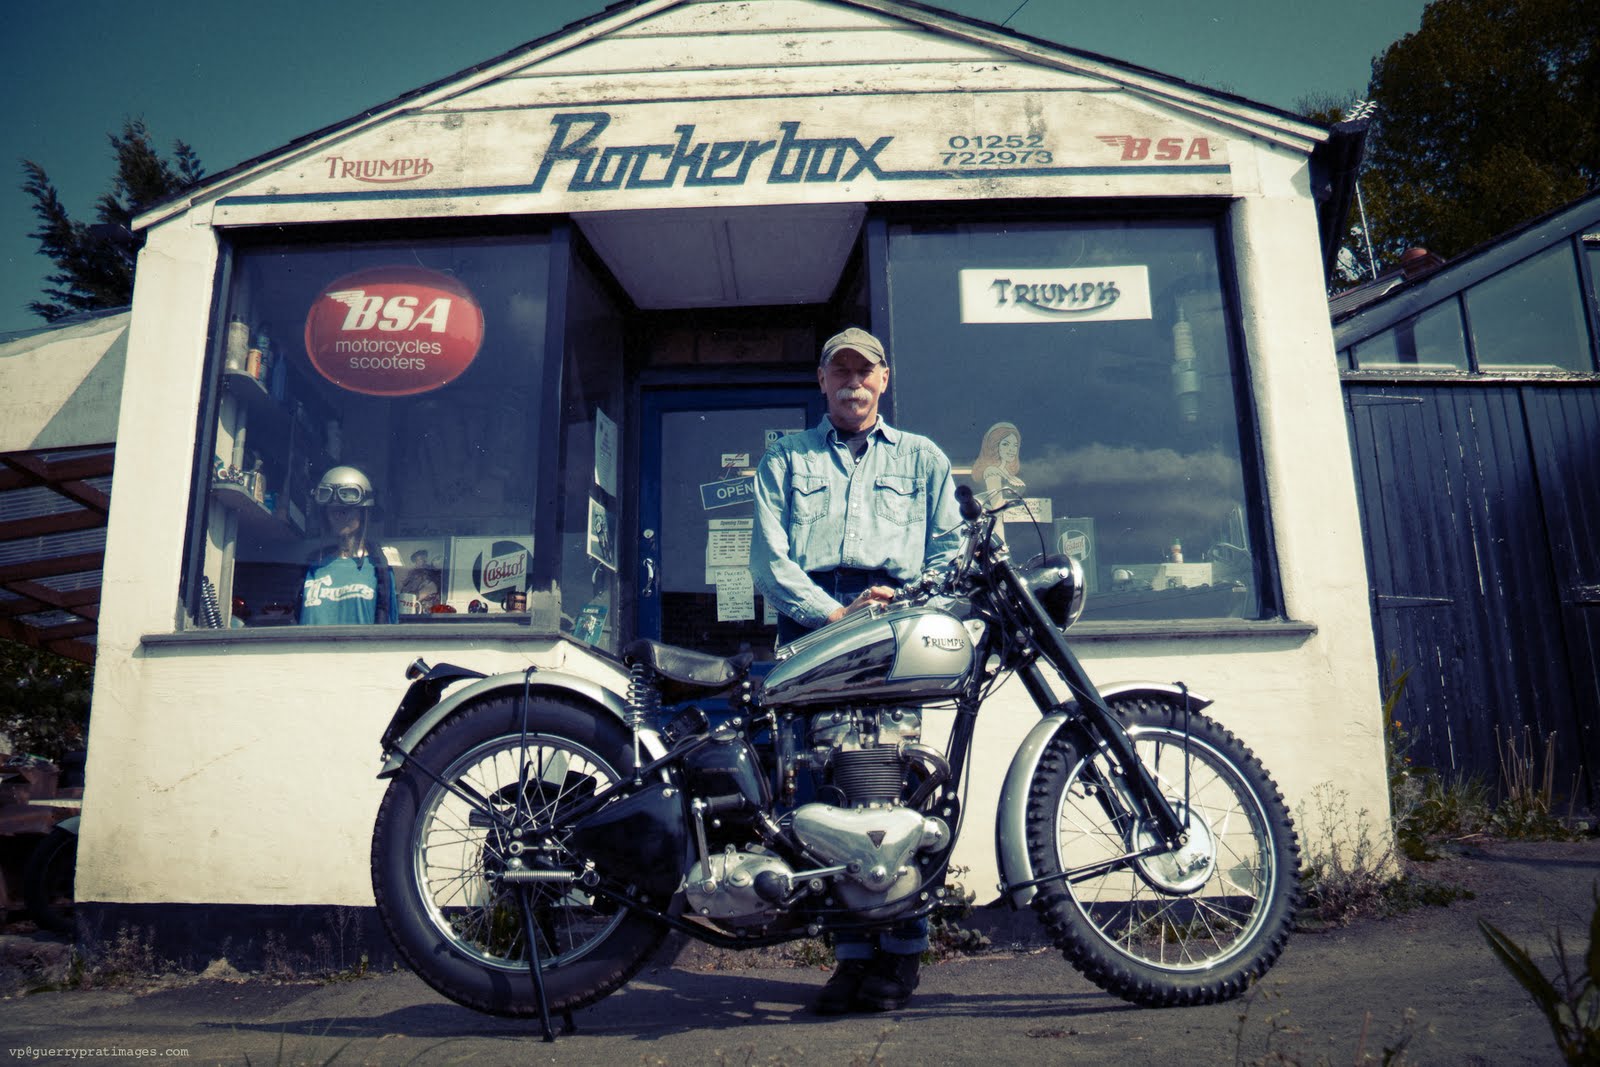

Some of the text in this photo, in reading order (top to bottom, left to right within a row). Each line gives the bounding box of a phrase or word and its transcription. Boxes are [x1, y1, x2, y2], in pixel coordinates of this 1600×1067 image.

[534, 112, 894, 192] Rockerbox
[947, 134, 1045, 150] 01252
[1117, 136, 1212, 162] BSA
[939, 150, 1054, 166] 722973
[325, 156, 434, 183] TRIUMPH
[989, 277, 1121, 316] TRIUMPH
[335, 291, 452, 334] BSA
[335, 338, 442, 356] motorcycles
[349, 354, 426, 370] scooters
[716, 482, 754, 499] OPEN
[483, 553, 526, 588] Castrol
[921, 635, 965, 651] TRIUMPH
